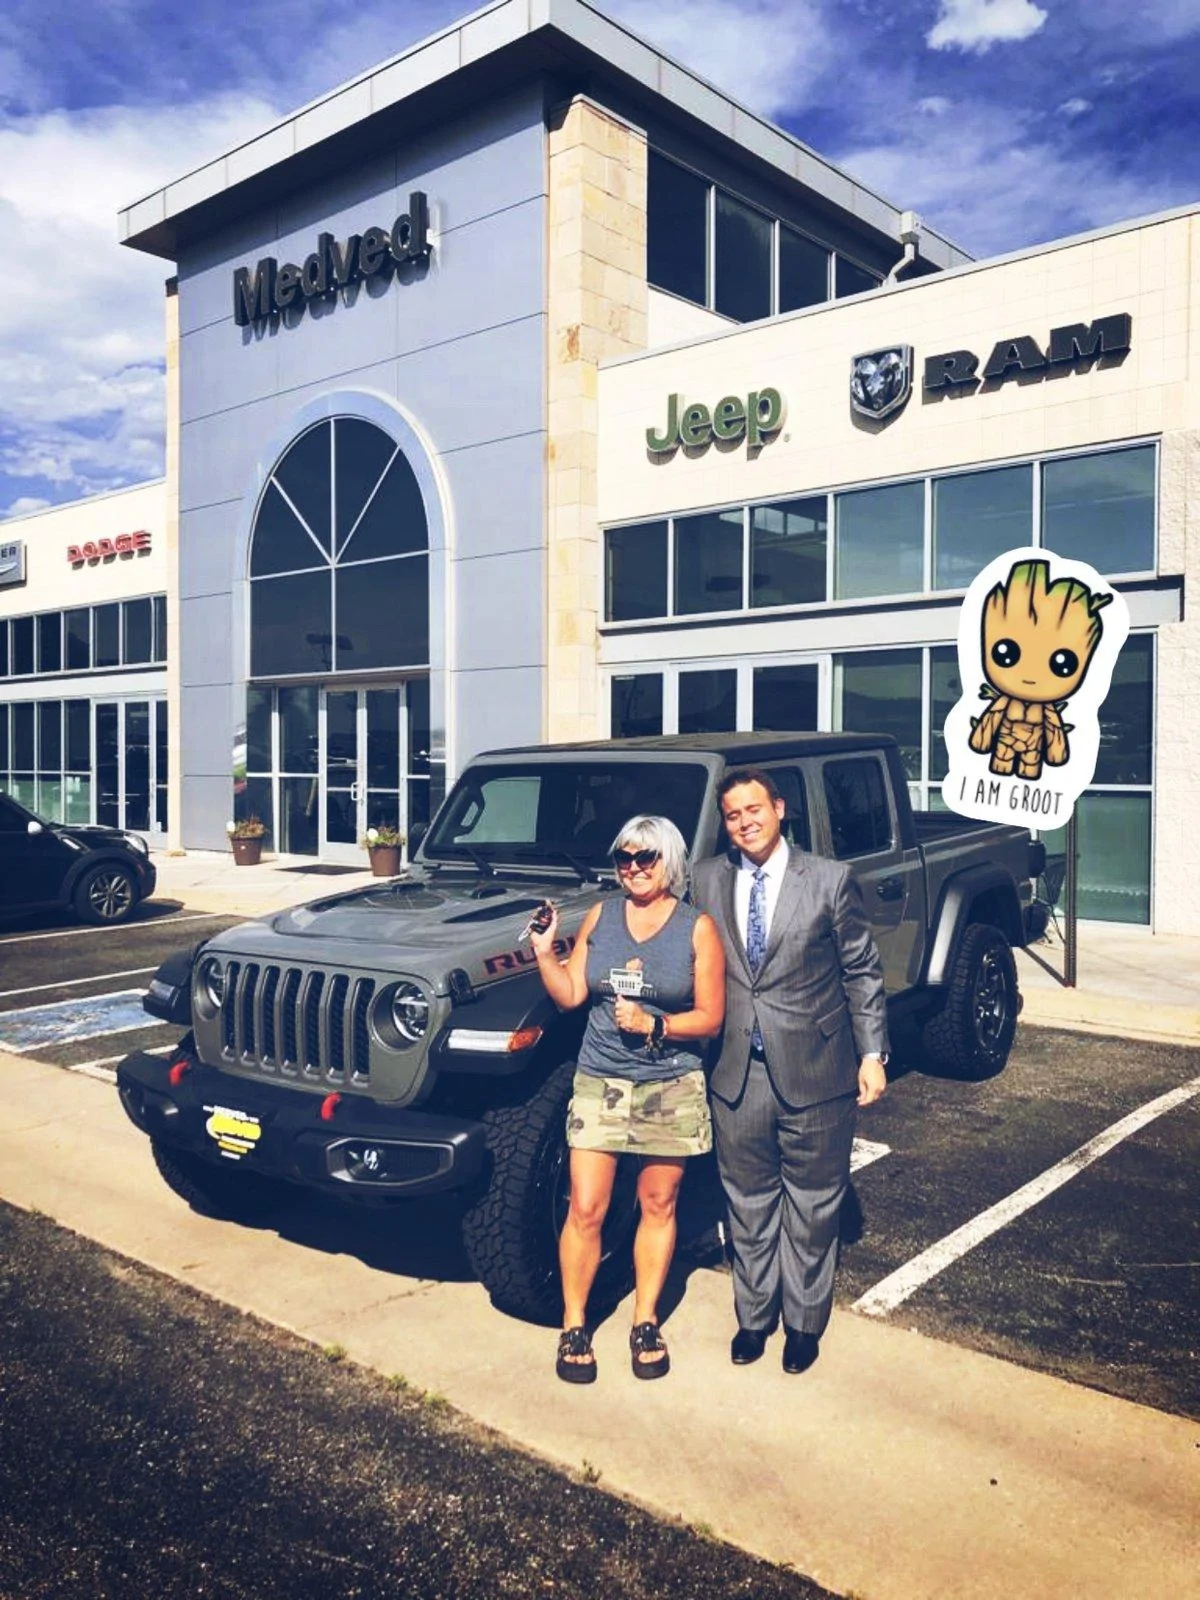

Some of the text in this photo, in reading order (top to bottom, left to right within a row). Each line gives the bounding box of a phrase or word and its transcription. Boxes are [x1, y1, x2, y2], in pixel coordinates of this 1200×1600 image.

[233, 190, 430, 327] Medved
[922, 312, 1132, 390] RAM
[645, 386, 787, 448] Jeep
[67, 530, 152, 562] DODGE
